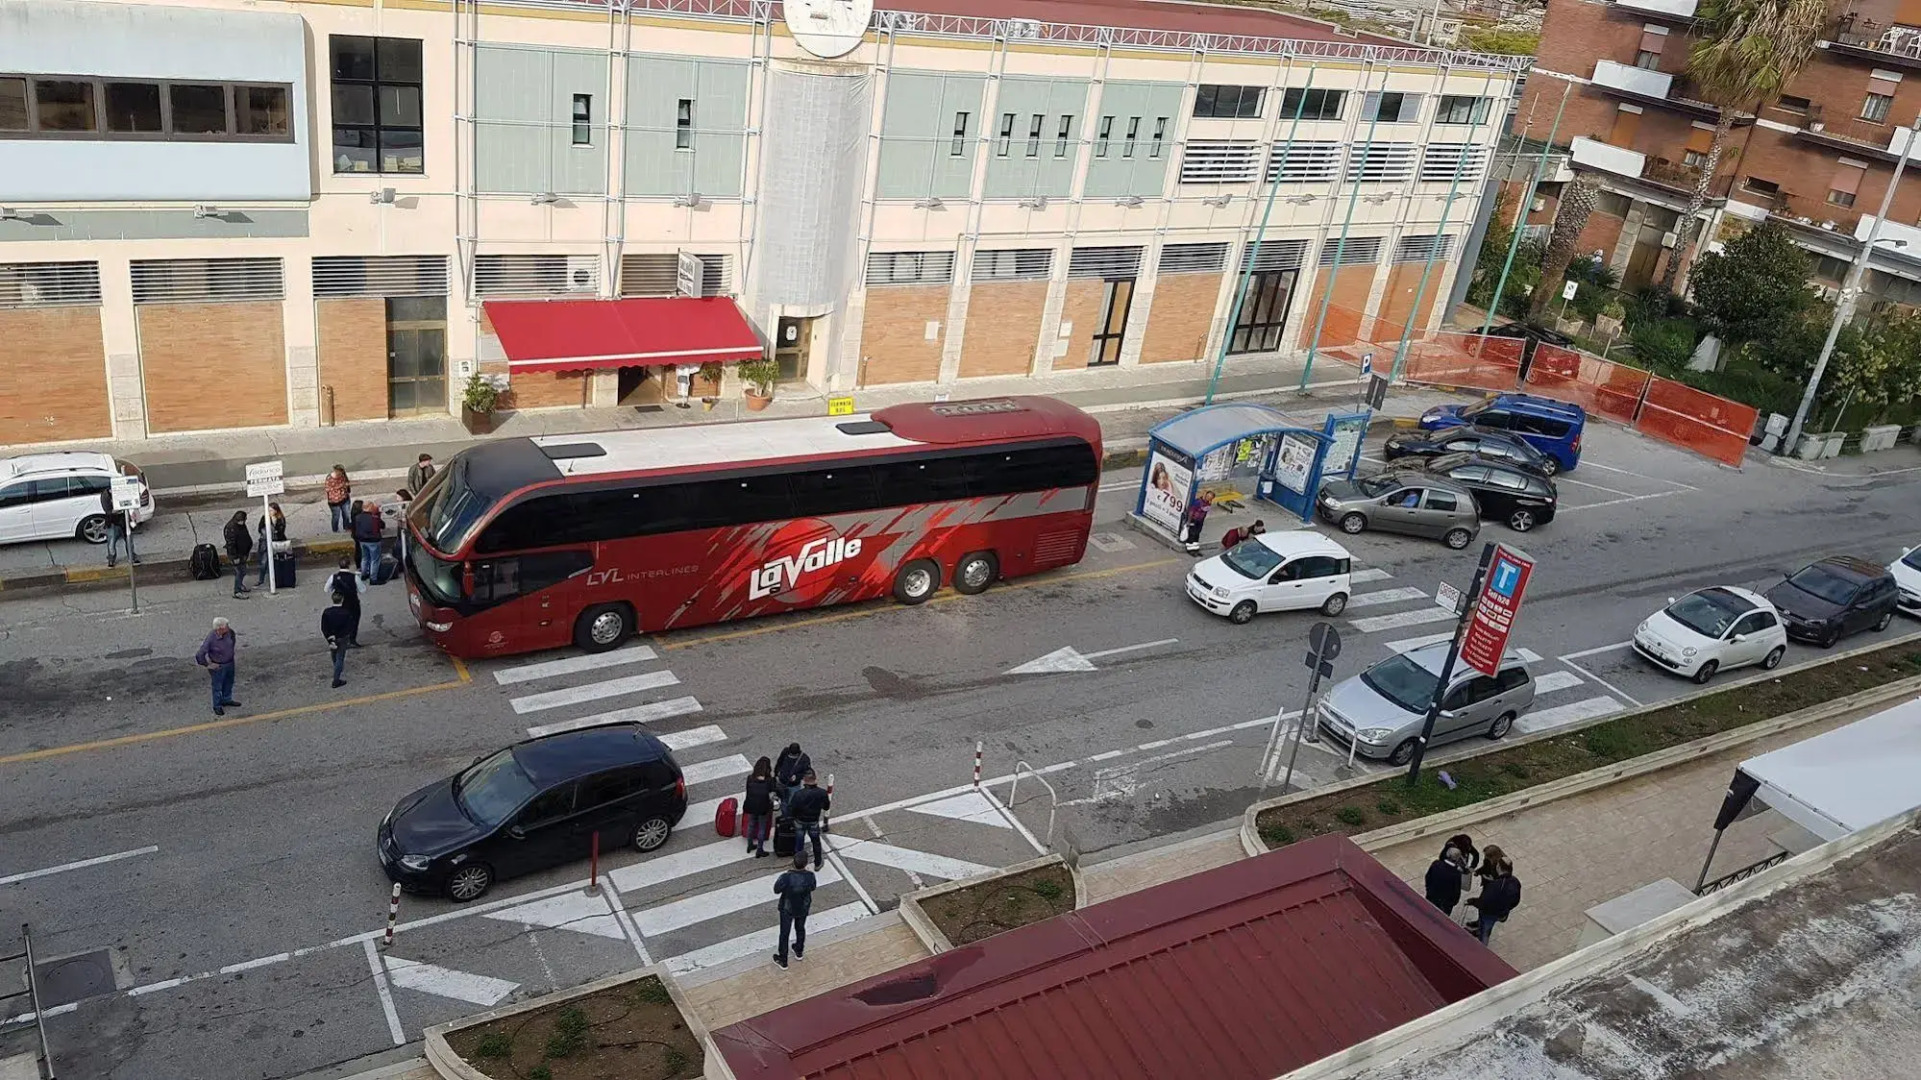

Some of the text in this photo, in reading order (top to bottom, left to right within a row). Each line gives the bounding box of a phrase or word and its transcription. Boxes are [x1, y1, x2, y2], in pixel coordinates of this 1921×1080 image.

[1362, 355, 1371, 374] P
[627, 565, 699, 580] INTERLINES
[1500, 561, 1517, 589] T
